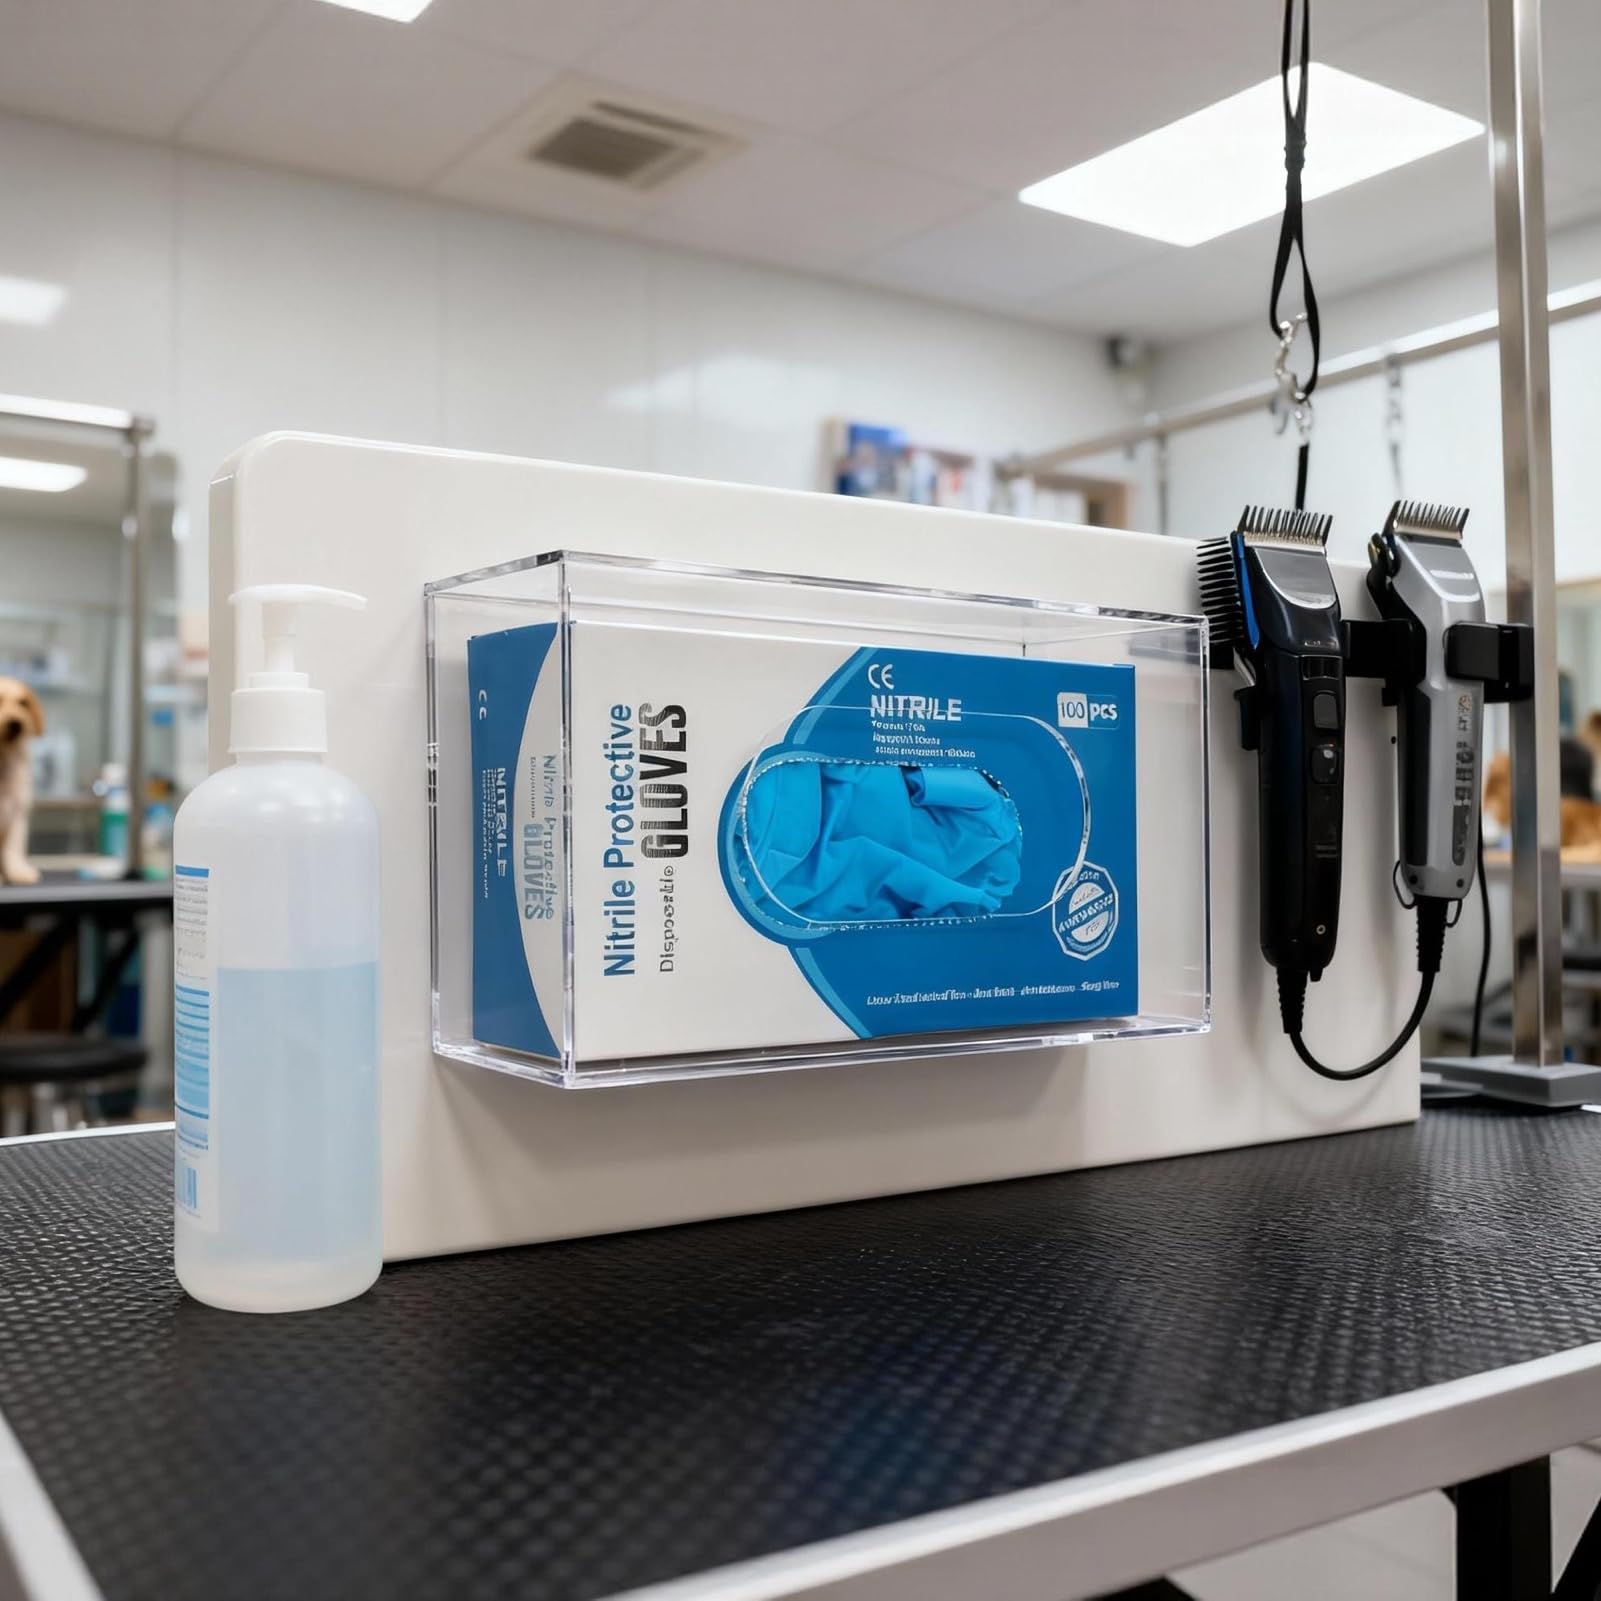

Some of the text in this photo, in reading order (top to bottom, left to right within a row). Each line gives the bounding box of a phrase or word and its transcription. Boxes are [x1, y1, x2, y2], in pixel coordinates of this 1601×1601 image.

[869, 694, 962, 722] NITRILE
[1061, 701, 1085, 719] 100
[637, 702, 689, 859] GLOVES
[602, 703, 636, 977] Nitrile Protective
